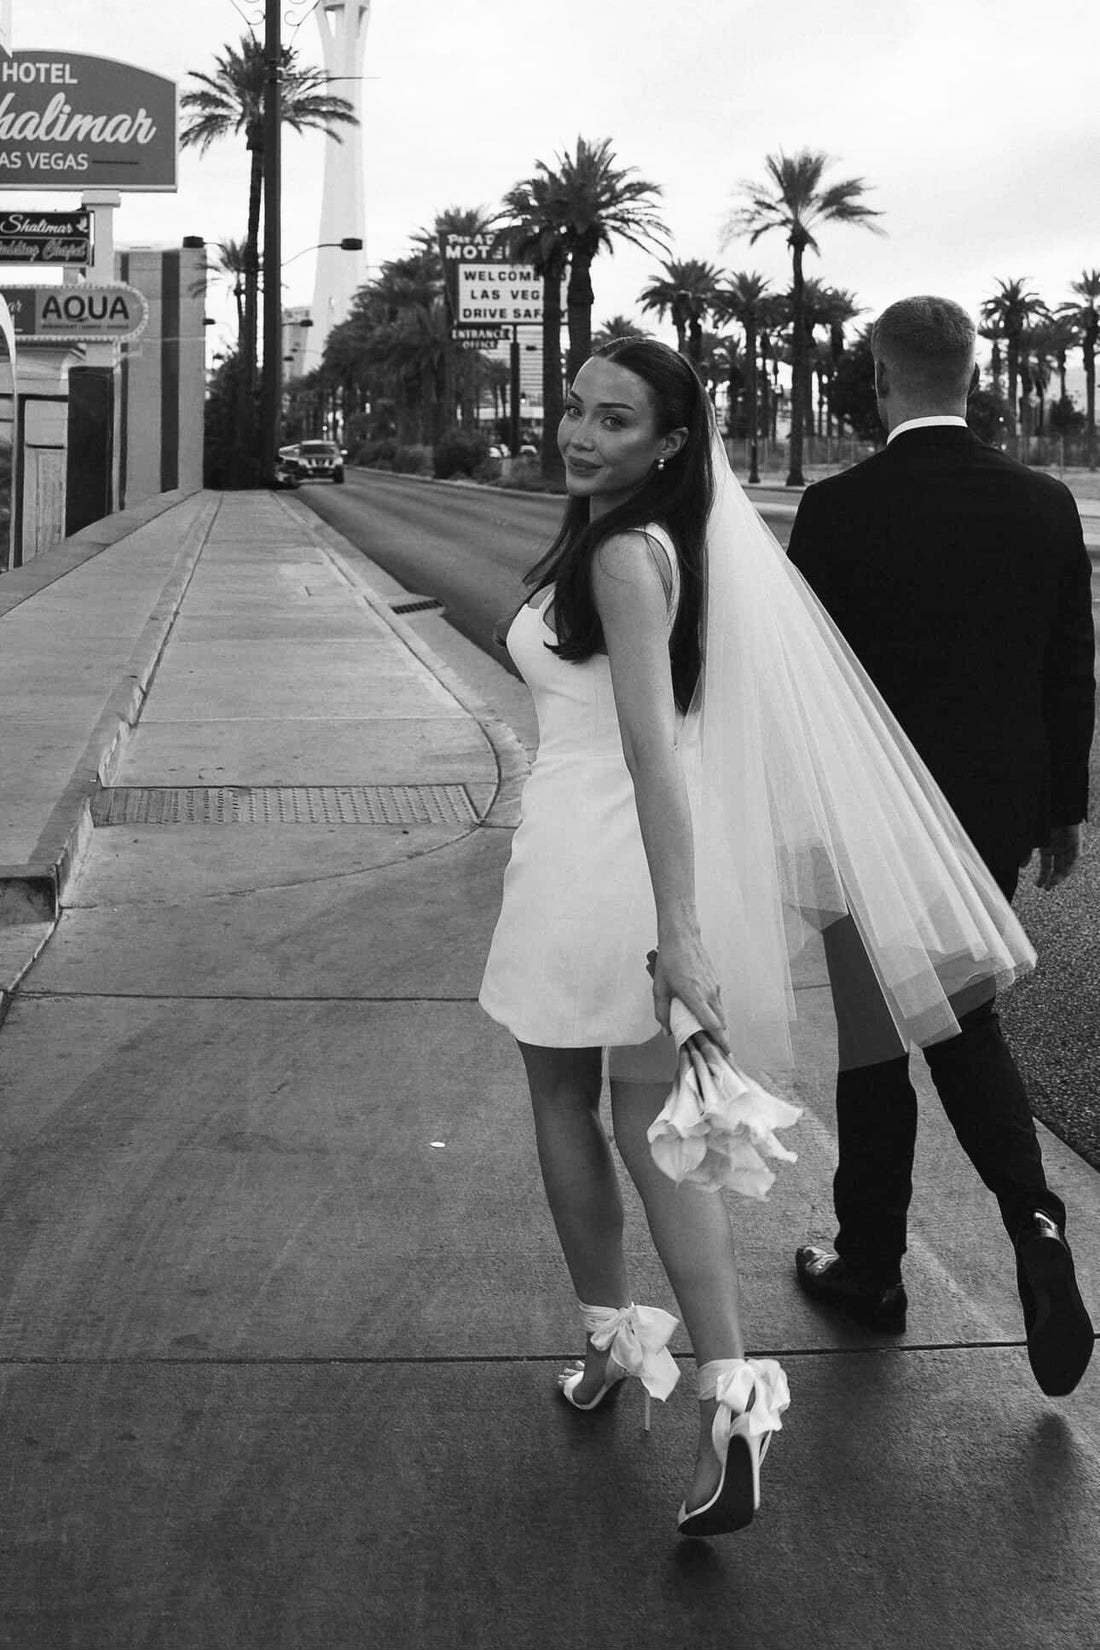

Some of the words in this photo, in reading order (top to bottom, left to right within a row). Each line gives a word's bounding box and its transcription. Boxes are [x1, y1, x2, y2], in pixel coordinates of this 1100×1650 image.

[2, 61, 78, 84] HOTEL
[0, 91, 158, 144] halimar
[0, 151, 22, 169] AS
[26, 152, 89, 171] VEGAS
[0, 213, 74, 235] Shalimar
[445, 245, 511, 260] MOTE
[470, 289, 501, 300] LAS
[510, 289, 540, 300] VEG
[41, 295, 130, 322] AQUA
[463, 307, 508, 319] DRIVE
